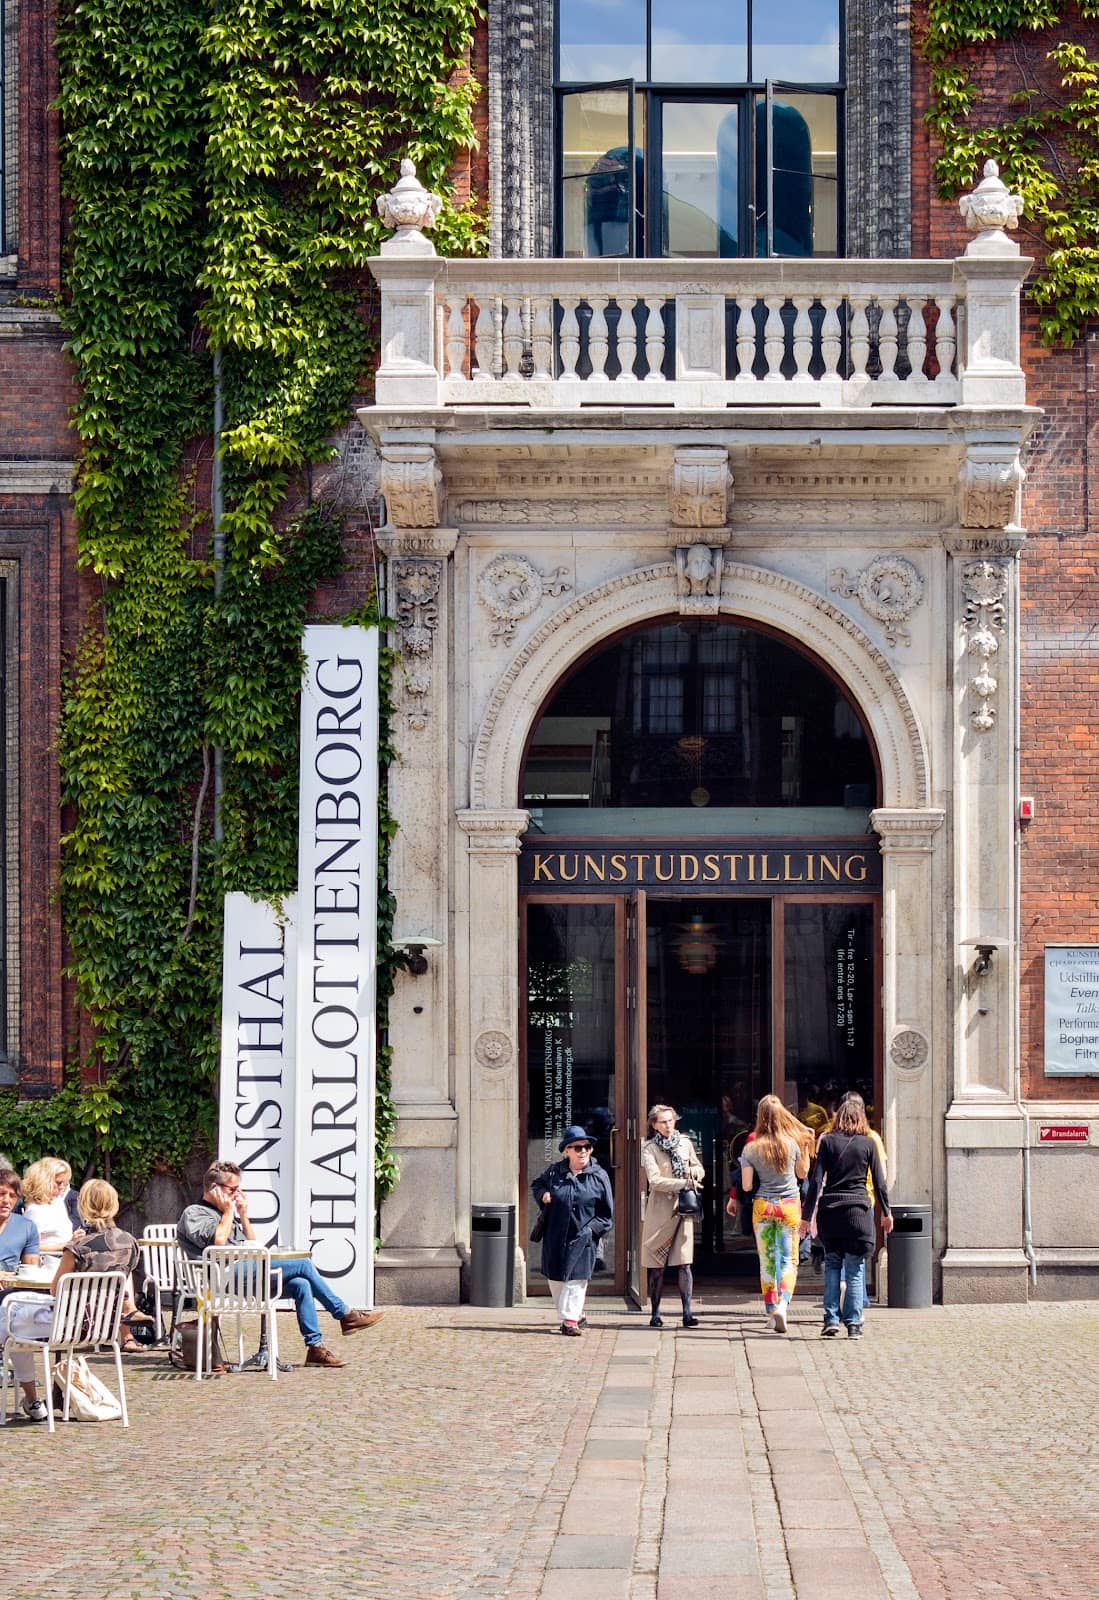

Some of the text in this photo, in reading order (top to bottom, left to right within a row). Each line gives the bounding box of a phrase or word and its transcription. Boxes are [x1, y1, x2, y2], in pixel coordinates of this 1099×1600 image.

[533, 853, 867, 881] KUNSTUDSTILLING
[310, 654, 363, 1279] CHARLOTTENBORG
[235, 923, 285, 1250] UNSTHAL
[544, 1030, 552, 1162] KUNSTHAL CHARLOTTENBORG
[555, 1047, 563, 1089] København
[555, 1092, 563, 1109] 1051
